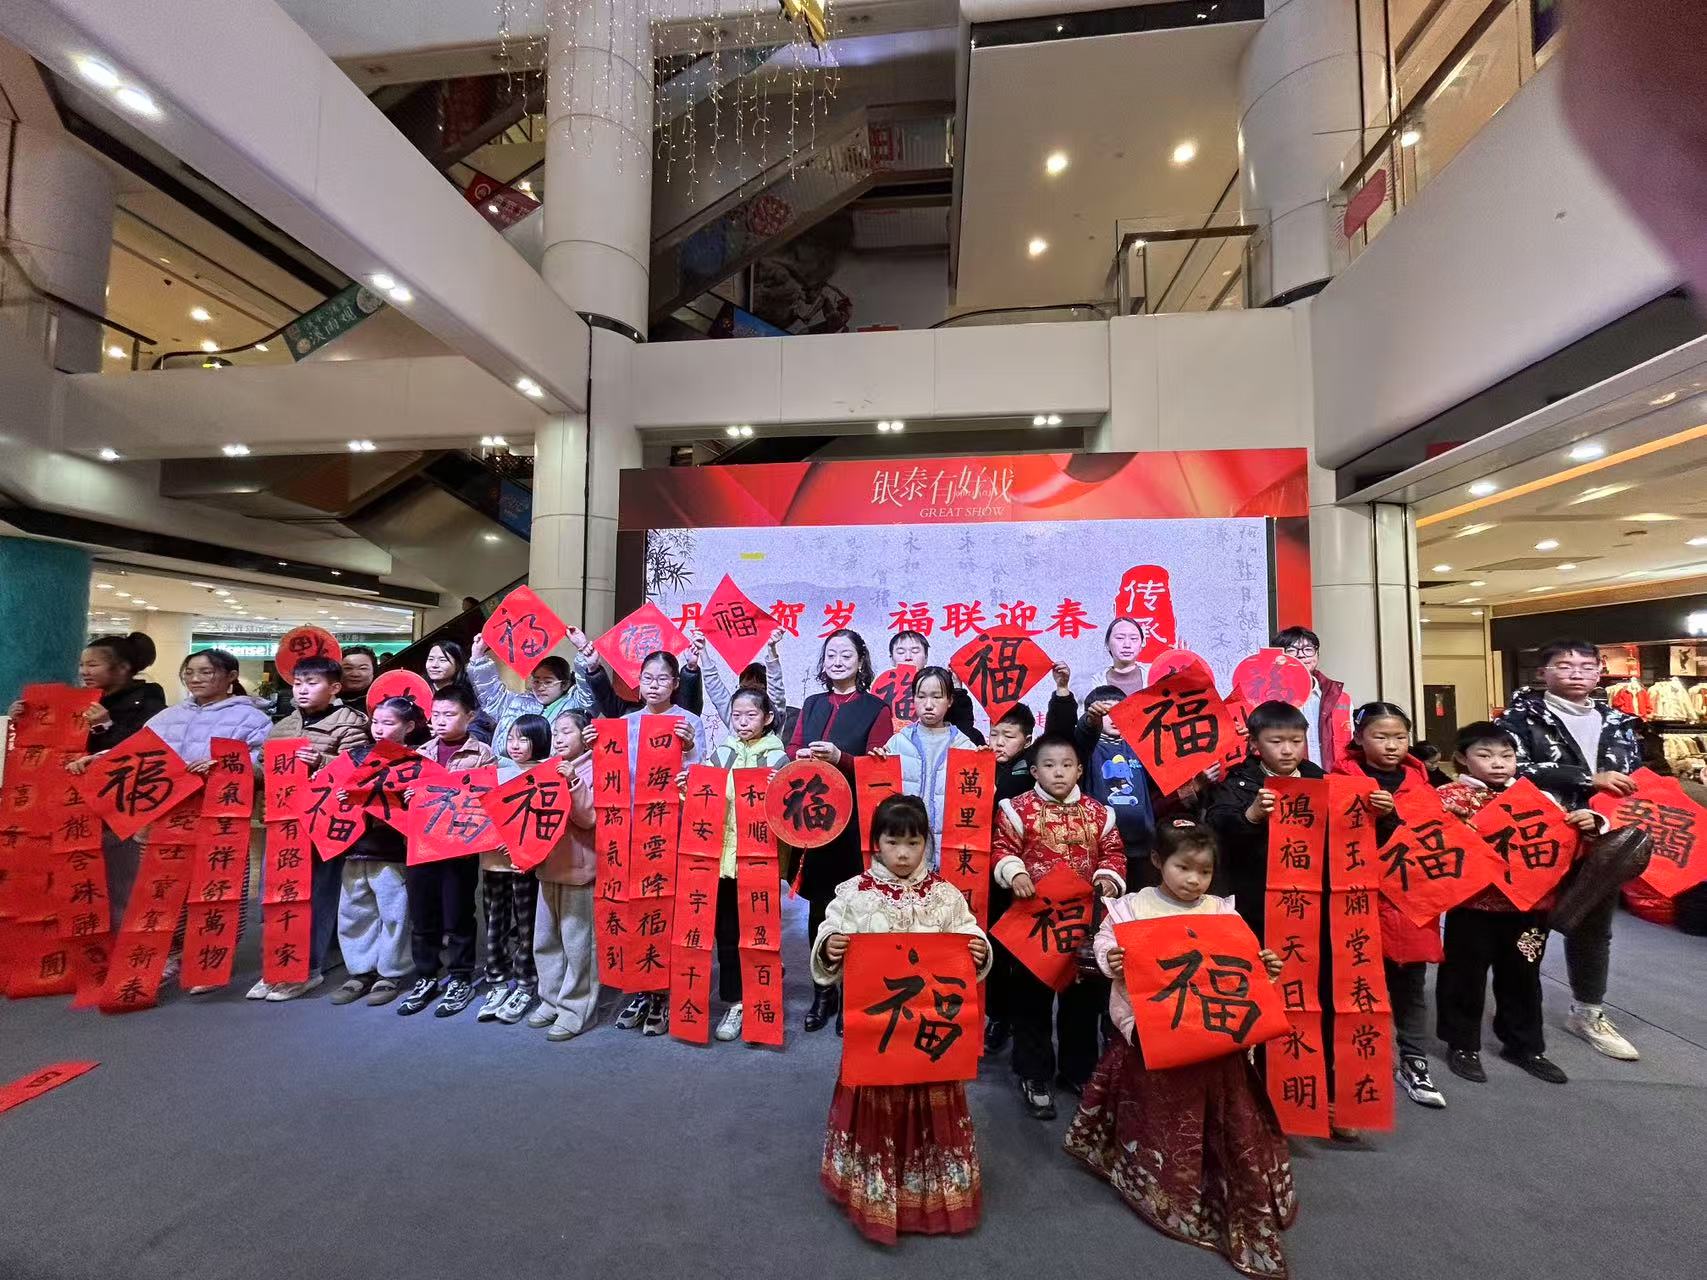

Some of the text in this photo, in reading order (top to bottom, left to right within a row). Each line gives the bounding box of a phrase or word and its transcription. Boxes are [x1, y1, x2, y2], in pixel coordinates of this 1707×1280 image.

[871, 465, 1015, 507] 银泰有好戏
[920, 507, 1005, 518] GREAT SHOW
[493, 607, 548, 663] 福
[671, 598, 1098, 638] 丹贺岁 福联迎春
[711, 601, 759, 640] 福
[964, 633, 1032, 707] 福
[1138, 688, 1219, 767] 福
[97, 749, 174, 817] 福
[304, 772, 356, 842] 福
[417, 773, 493, 845] 福
[500, 774, 566, 846] 福
[783, 773, 836, 832] 福
[601, 738, 628, 973] 九州瑞氣迎春到
[1380, 818, 1466, 892] 福
[1482, 803, 1560, 885] 福
[1027, 895, 1091, 955] 福
[1276, 794, 1318, 1110] 鴻福齊天日永明
[863, 947, 967, 1063] 福
[1147, 927, 1262, 1043] 福
